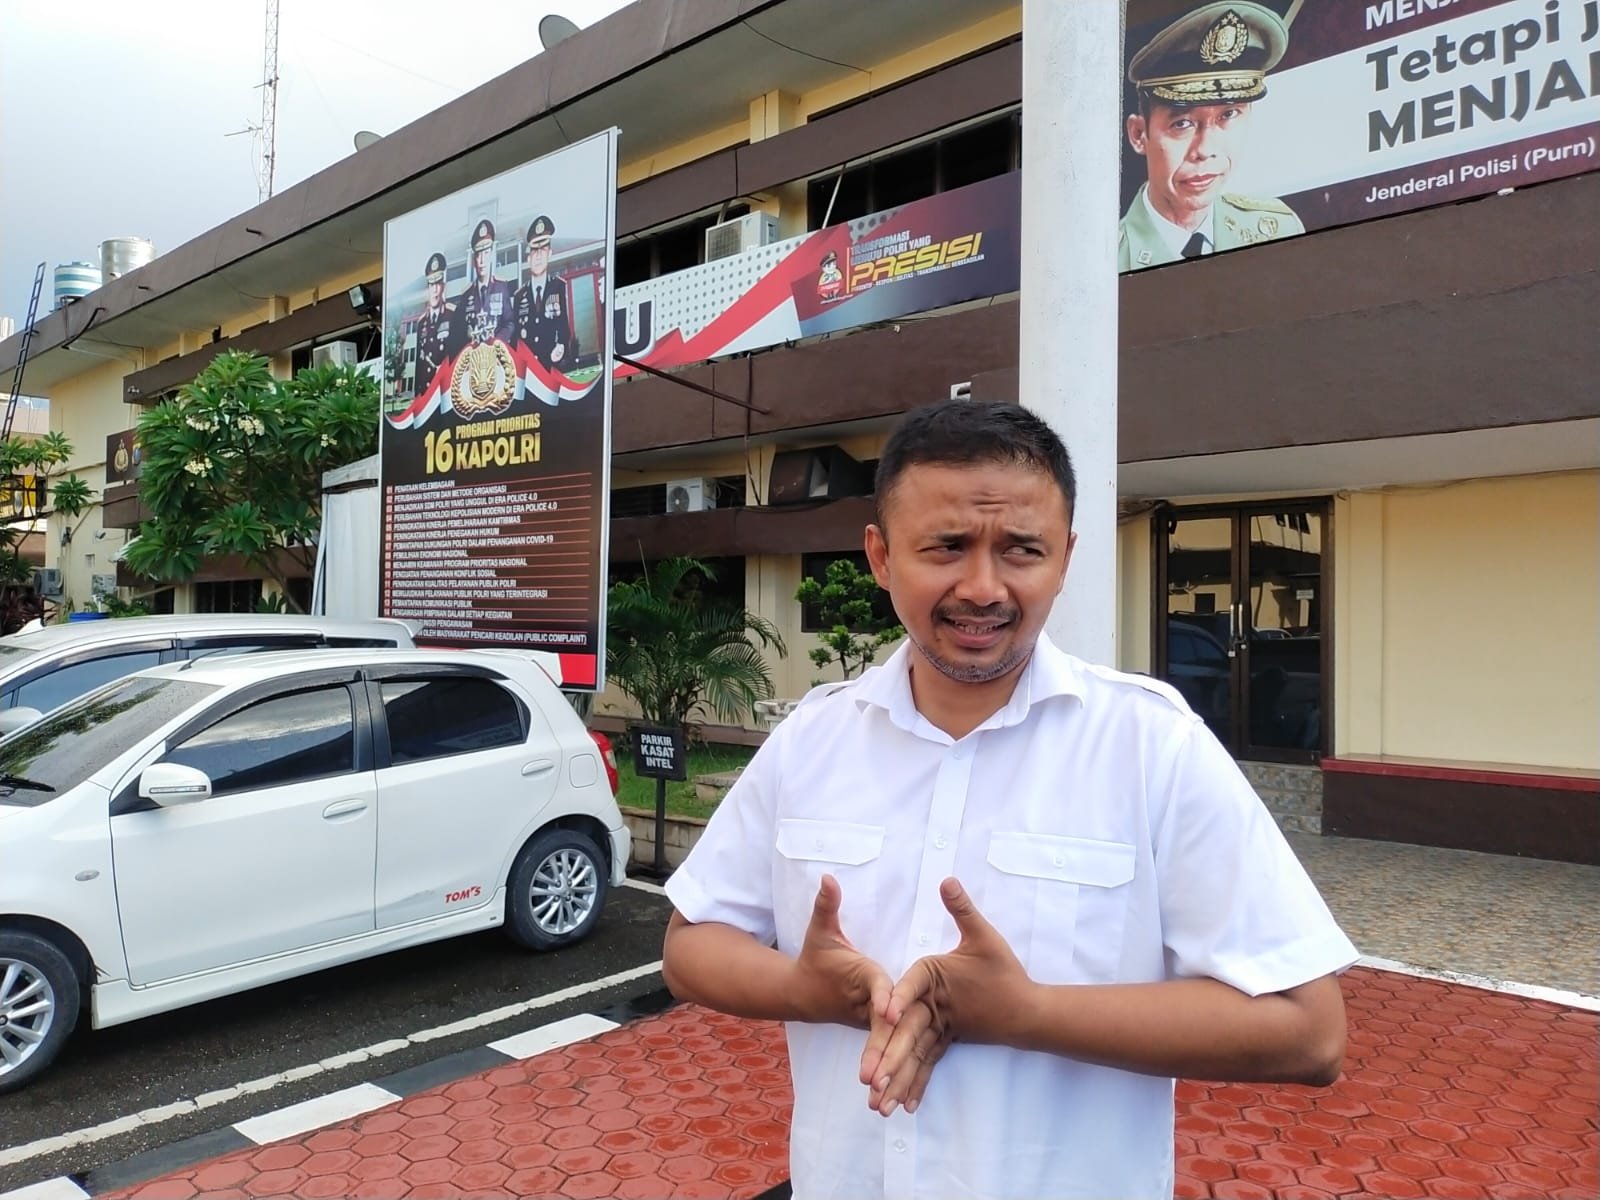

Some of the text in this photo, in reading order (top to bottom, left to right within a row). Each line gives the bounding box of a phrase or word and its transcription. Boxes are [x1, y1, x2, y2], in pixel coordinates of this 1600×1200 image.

[1366, 0, 1460, 31] MEN
[1366, 0, 1560, 92] Tetapi
[1365, 136, 1596, 203] Jenderal Polisi (Purn)
[883, 241, 908, 257] POLRI
[909, 234, 932, 250] YANG
[851, 232, 982, 287] PRESISI
[456, 412, 541, 439] PROGRAM PRIORITAS
[424, 428, 454, 475] 16
[455, 432, 541, 471] KAPOLRI
[473, 485, 506, 495] ORGANISASI
[450, 499, 464, 508] YANG
[488, 496, 494, 504] DI
[494, 495, 505, 504] ERA
[506, 494, 527, 503] POLICE
[528, 493, 537, 501] 4.0
[506, 505, 512, 513] DI
[513, 504, 524, 513] ERA
[525, 503, 546, 512] POLICE
[547, 502, 557, 510] 4.0
[479, 528, 499, 536] HUKUM
[468, 538, 486, 547] DALAM
[487, 536, 524, 546] PENANGANAN
[526, 535, 553, 544] COVID-19
[470, 558, 497, 567] PRIORITAS
[498, 558, 527, 566] NASIONAL
[470, 631, 494, 639] PENCARI
[495, 632, 522, 641] KEADILAN
[524, 633, 547, 642] (PUBLIC
[548, 634, 586, 643] COMPLAINT)
[640, 733, 672, 746] PARKIR
[640, 744, 675, 759] KASAT
[646, 757, 673, 770] INTEL
[445, 885, 482, 903] TOM'S
